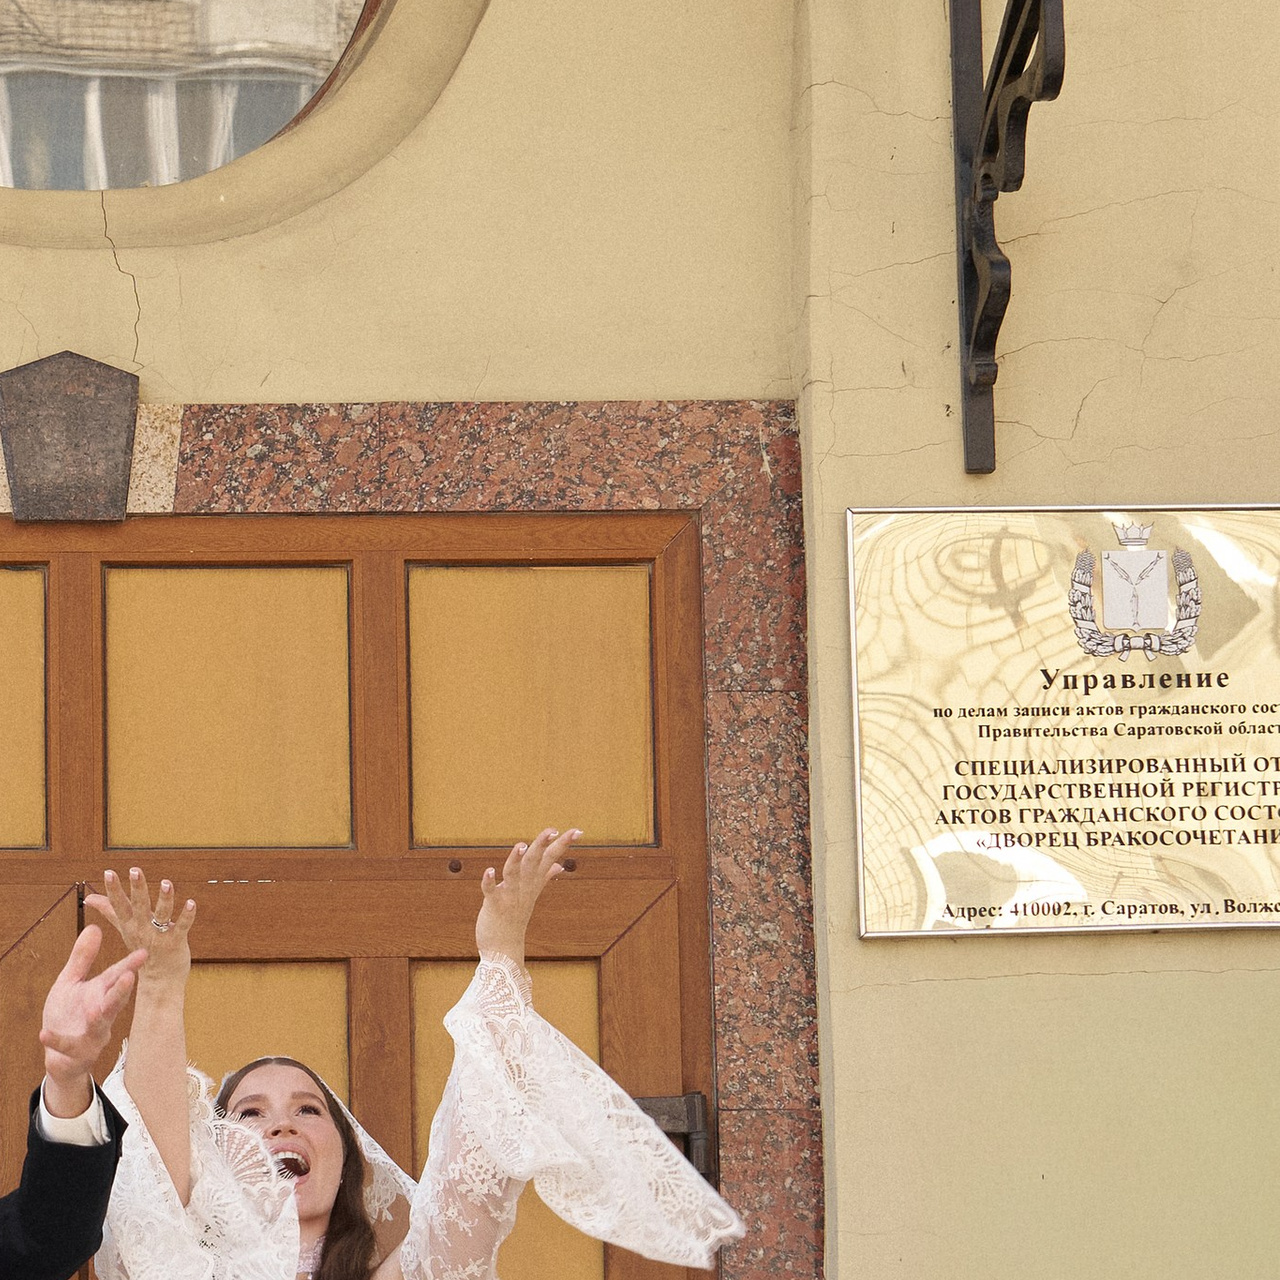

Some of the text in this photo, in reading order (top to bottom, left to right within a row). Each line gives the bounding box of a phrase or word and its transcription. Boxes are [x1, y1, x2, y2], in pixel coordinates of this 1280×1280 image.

[1040, 668, 1230, 696] Управление
[933, 707, 953, 718] по
[957, 706, 1008, 718] делам
[1013, 706, 1070, 717] записи
[1076, 705, 1124, 716] актов
[1129, 704, 1247, 719] гражданского
[978, 724, 1108, 742] Правительства
[1113, 722, 1223, 740] Саратовской
[954, 753, 1247, 778] СПЕЦИАЛИЗИРОВАННЫЙ
[942, 778, 1175, 802] ГОСУДАРСТВЕННОЙ
[935, 804, 1280, 826] АКТОВ ГРАЖДАНСКОГО СОСТ
[976, 831, 1079, 850] «ДВОРЕЦ
[942, 903, 1003, 921] Адрес:
[1009, 901, 1078, 917] 410002,
[1083, 904, 1095, 916] г.
[1101, 900, 1185, 918] Саратов,
